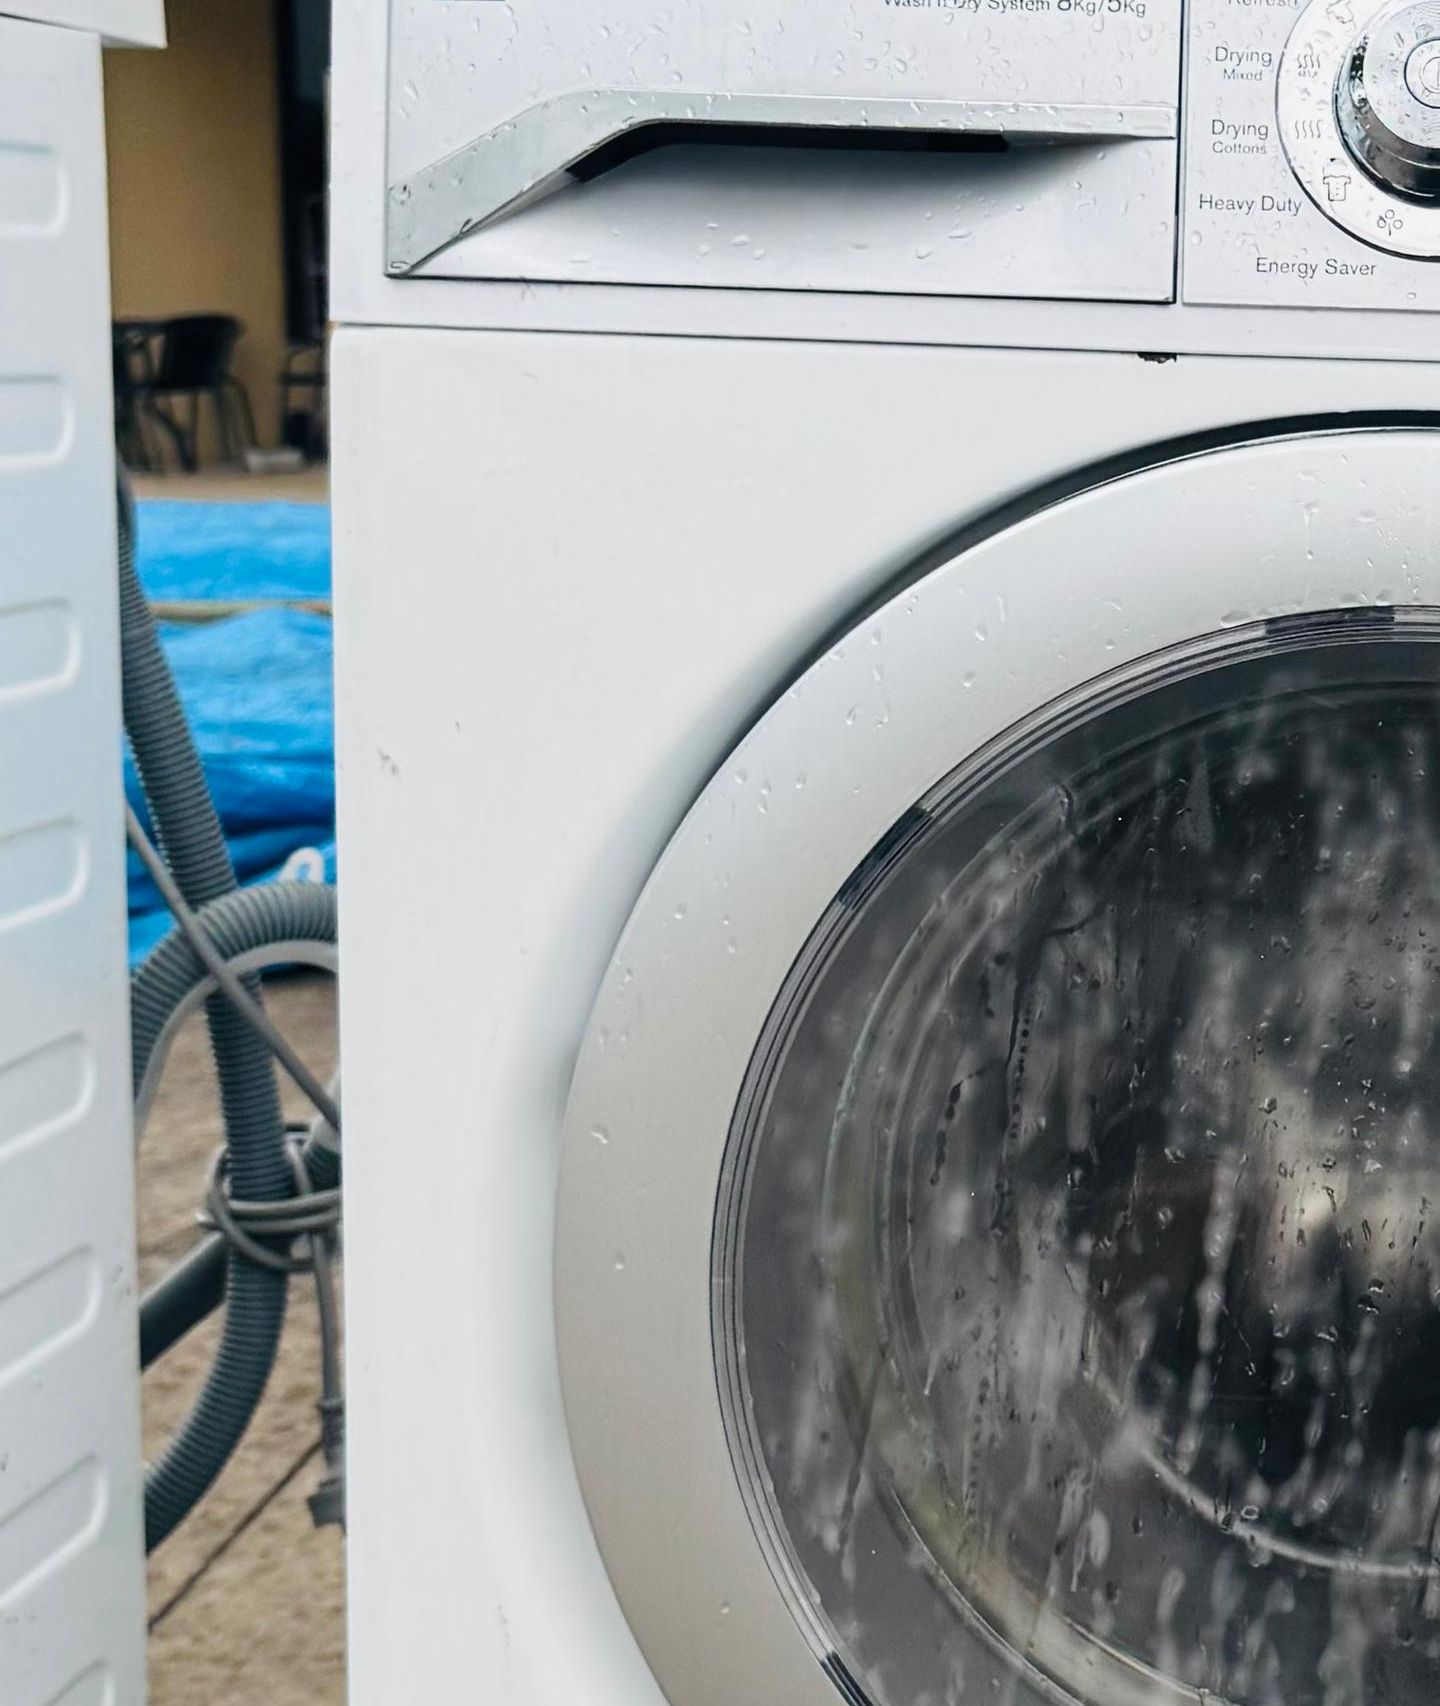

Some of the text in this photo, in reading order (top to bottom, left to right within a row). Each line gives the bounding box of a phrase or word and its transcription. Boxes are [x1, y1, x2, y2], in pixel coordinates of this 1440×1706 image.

[1214, 46, 1273, 67] Drying
[1223, 68, 1263, 81] Mixed
[1211, 119, 1269, 141] Drying
[1212, 141, 1267, 155] Cottons
[1199, 193, 1302, 216] Heavy Duty
[1256, 257, 1377, 279] Energy Saver
